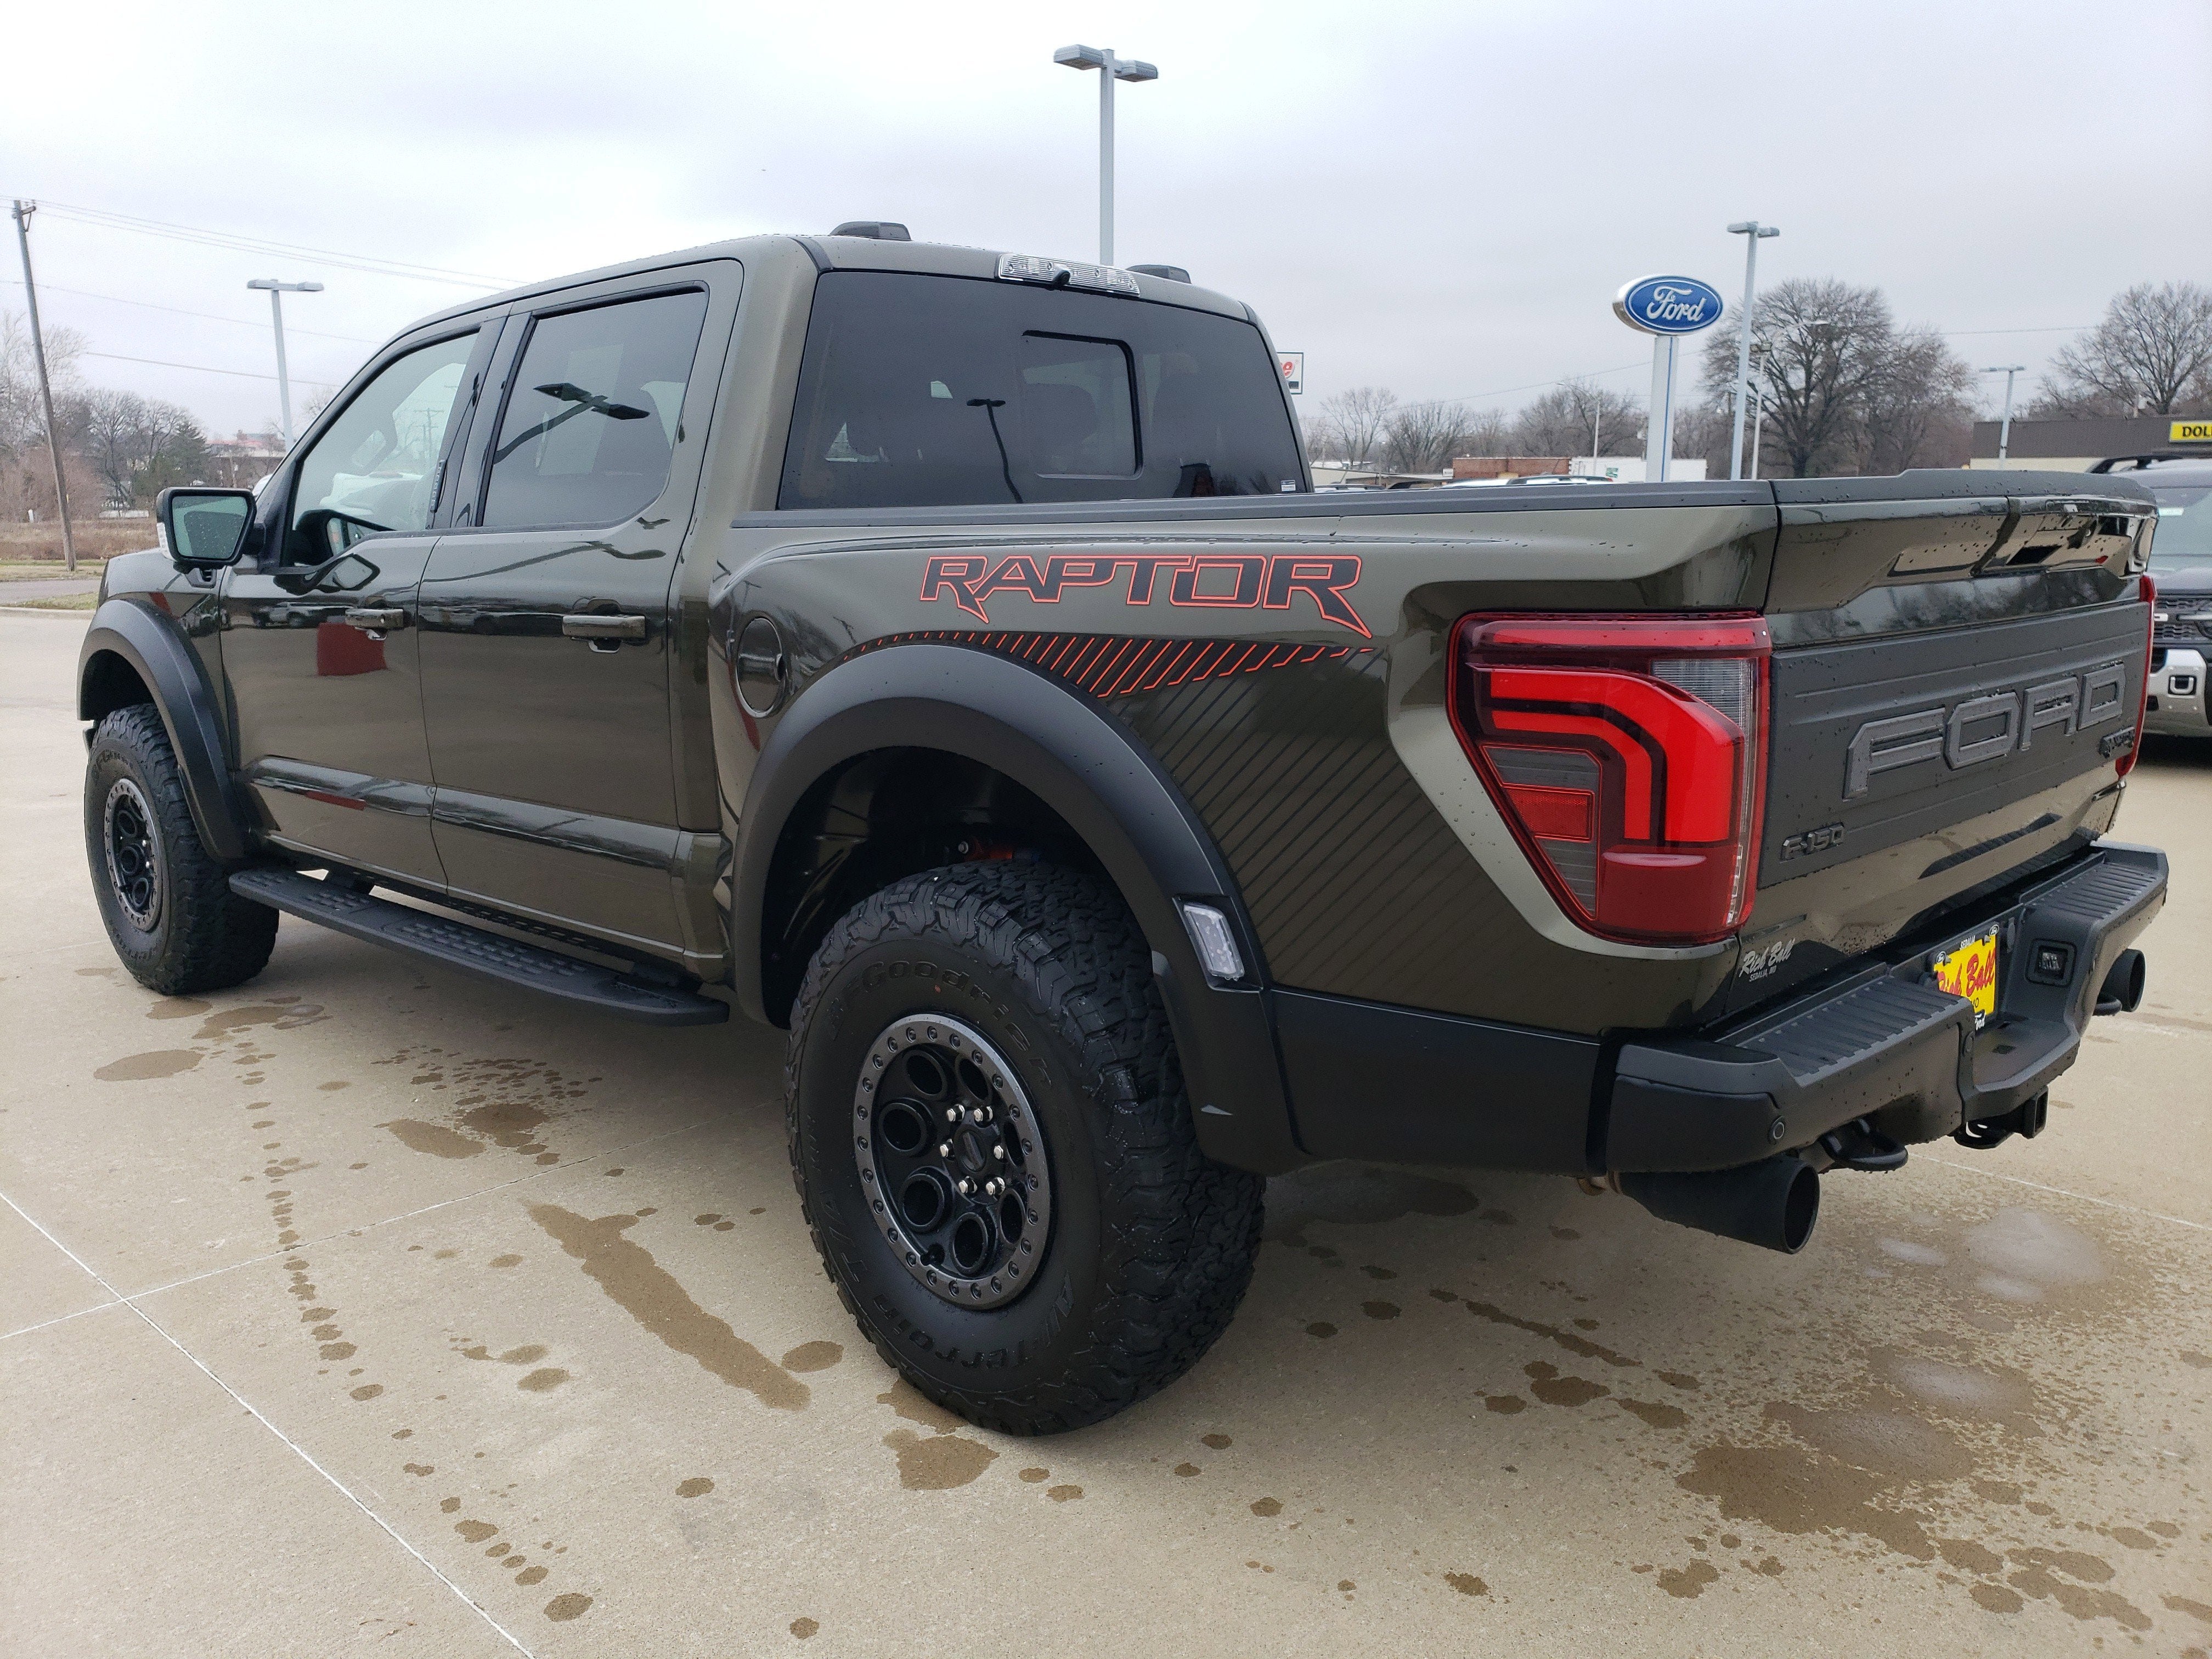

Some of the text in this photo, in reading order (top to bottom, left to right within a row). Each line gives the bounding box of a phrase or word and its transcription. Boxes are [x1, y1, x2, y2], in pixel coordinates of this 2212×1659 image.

[1646, 285, 1707, 322] Ford
[2182, 426, 2212, 437] DOL
[920, 555, 1372, 639] RAPTOR
[1843, 659, 2127, 802] FORD
[1779, 822, 1844, 863] F-150
[1768, 938, 1796, 967] Ball
[1966, 947, 1996, 997] Ball
